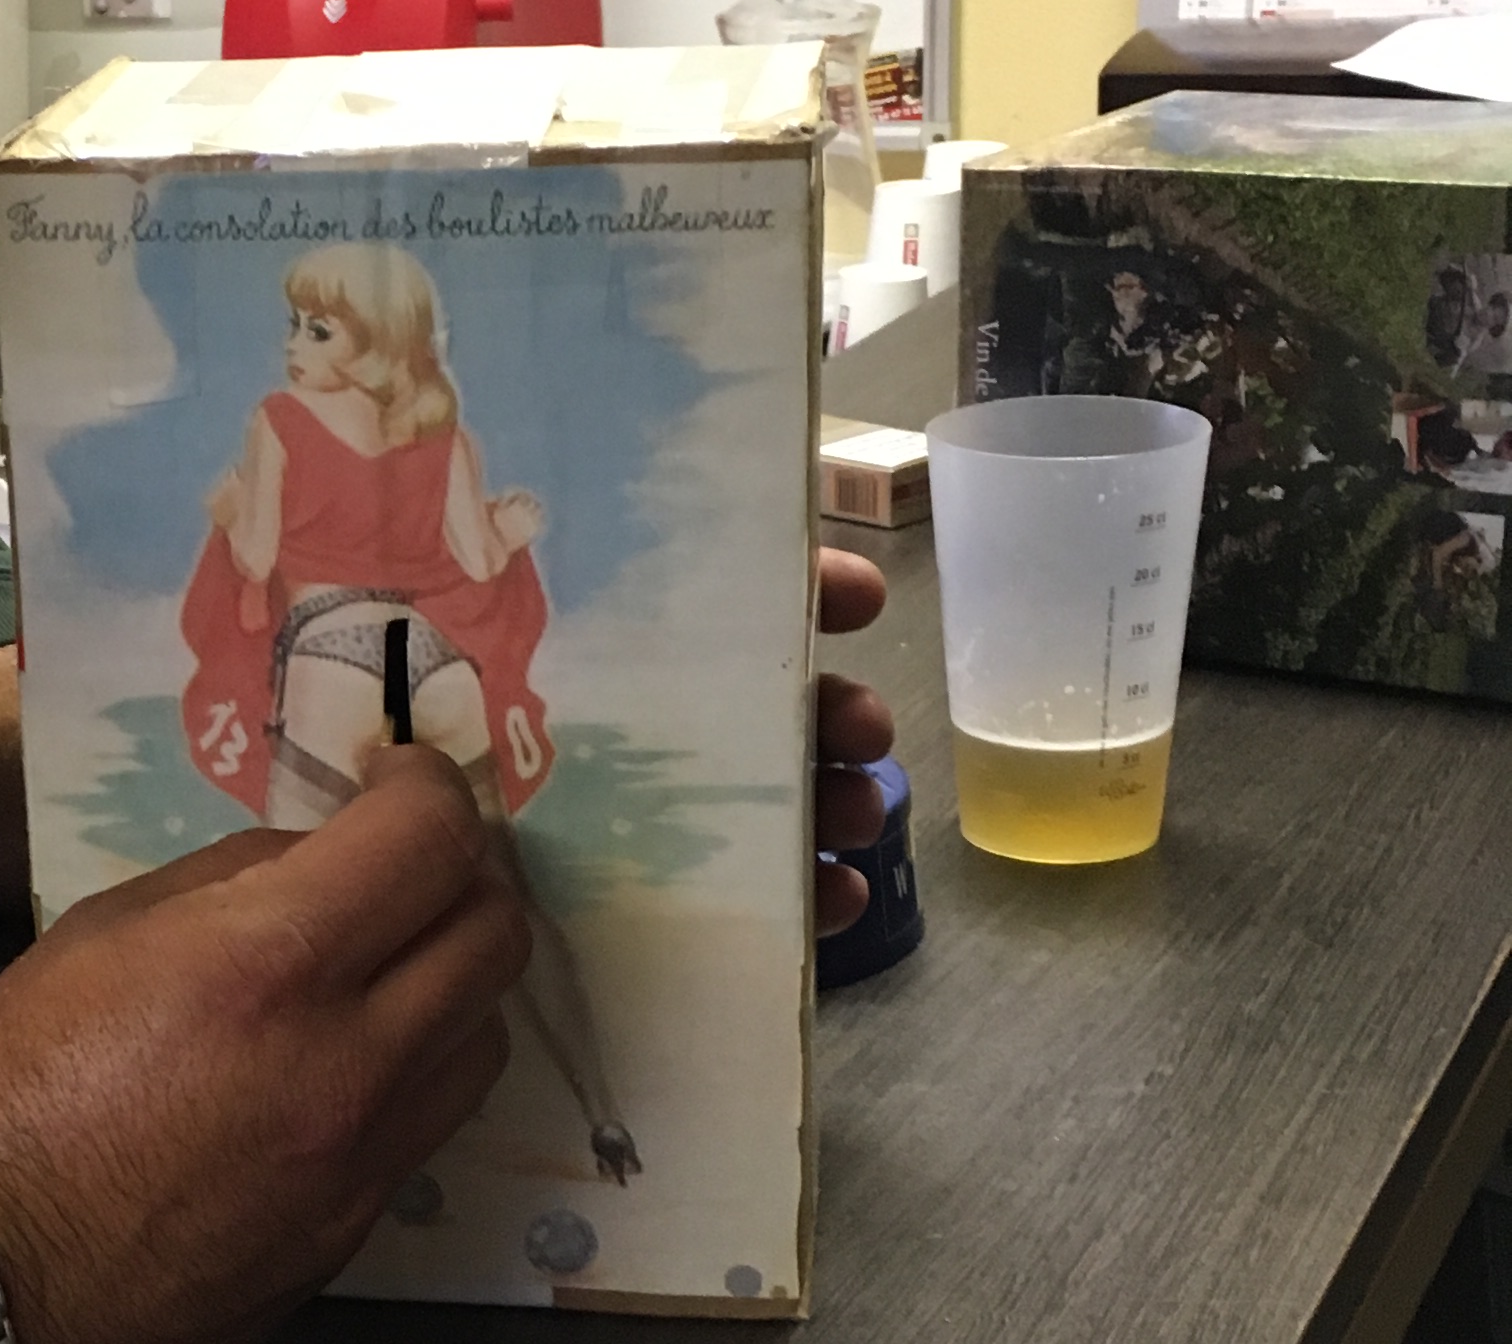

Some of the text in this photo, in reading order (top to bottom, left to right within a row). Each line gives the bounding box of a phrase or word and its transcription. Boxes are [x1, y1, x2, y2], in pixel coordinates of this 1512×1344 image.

[131, 190, 170, 244] la
[172, 195, 352, 244] consolation
[361, 196, 417, 240] des
[426, 188, 581, 239] boulistes
[974, 319, 1000, 397] Vin de
